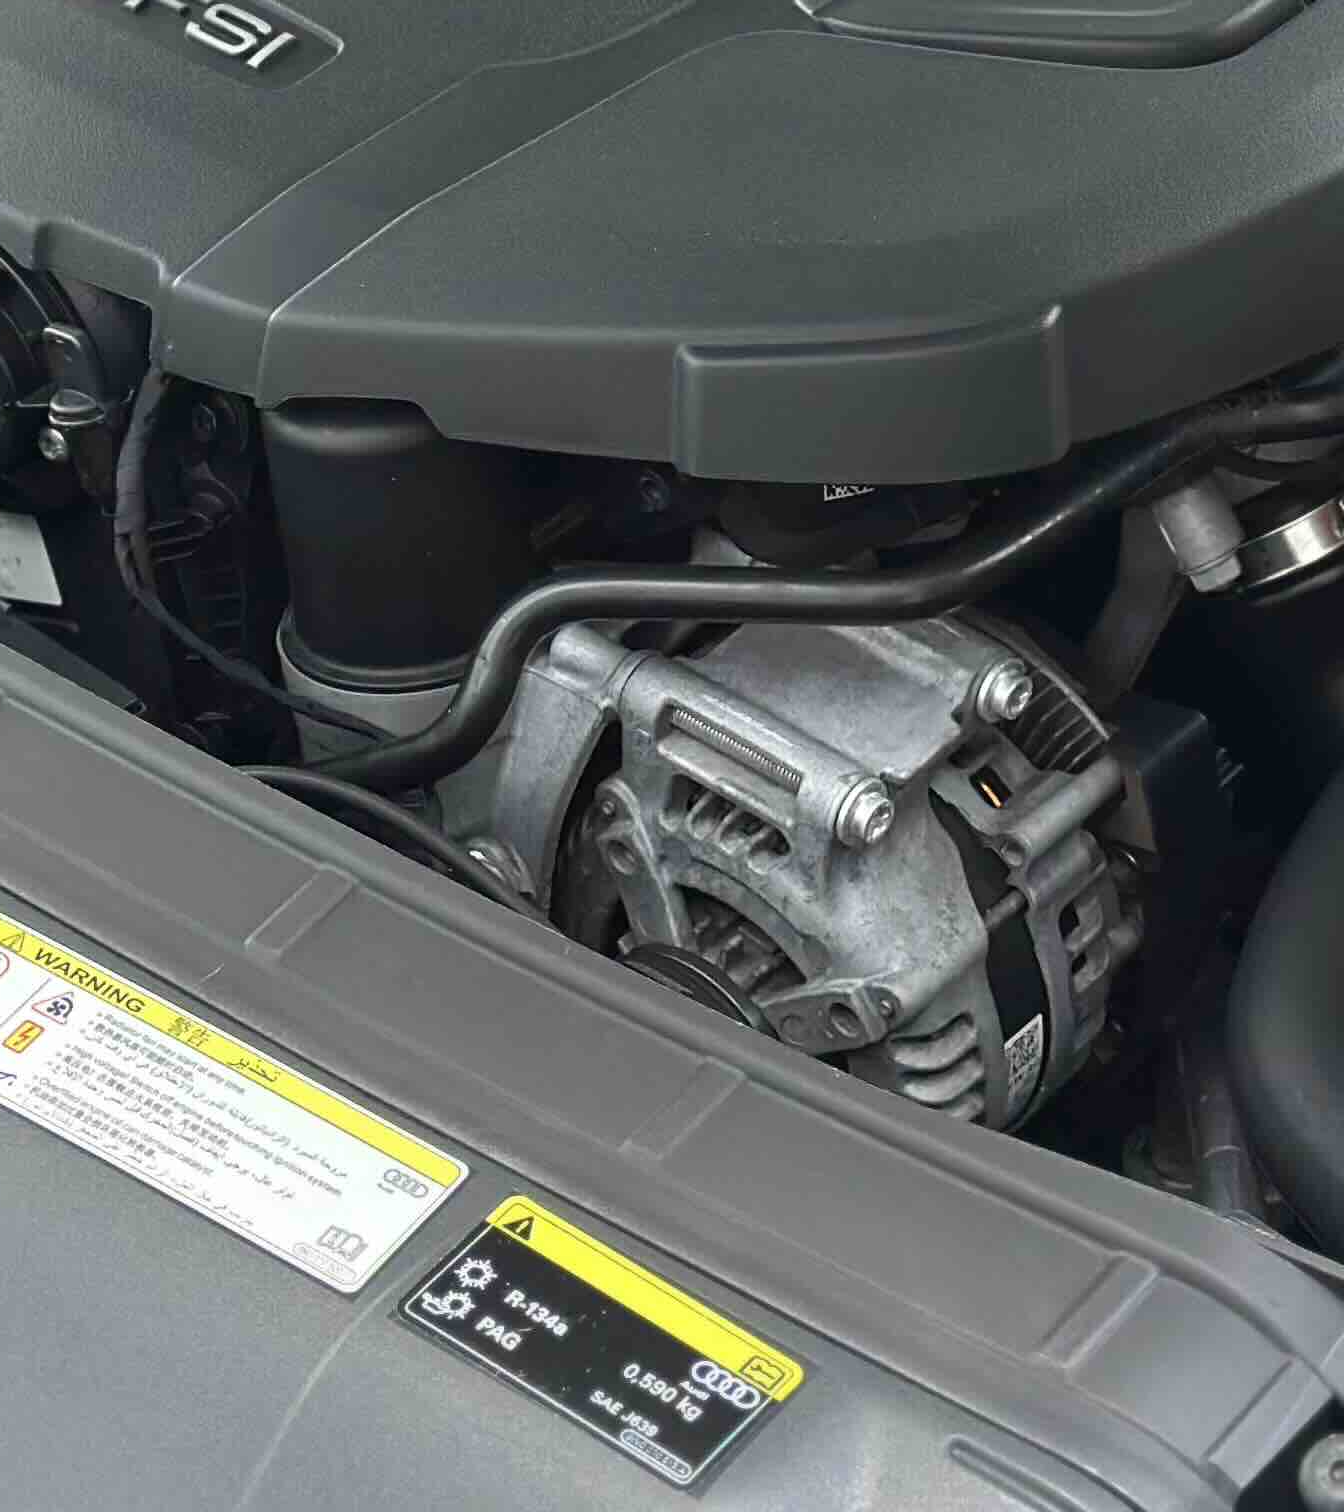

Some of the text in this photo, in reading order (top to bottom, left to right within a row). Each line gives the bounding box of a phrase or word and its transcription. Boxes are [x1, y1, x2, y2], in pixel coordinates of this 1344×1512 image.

[34, 947, 147, 1014] WARNING
[168, 1016, 209, 1047] 警告
[475, 1315, 522, 1351] PAG
[589, 1389, 623, 1417] SAE
[504, 1289, 704, 1422] R-134a 0,590 kg
[678, 1380, 711, 1401] Audi
